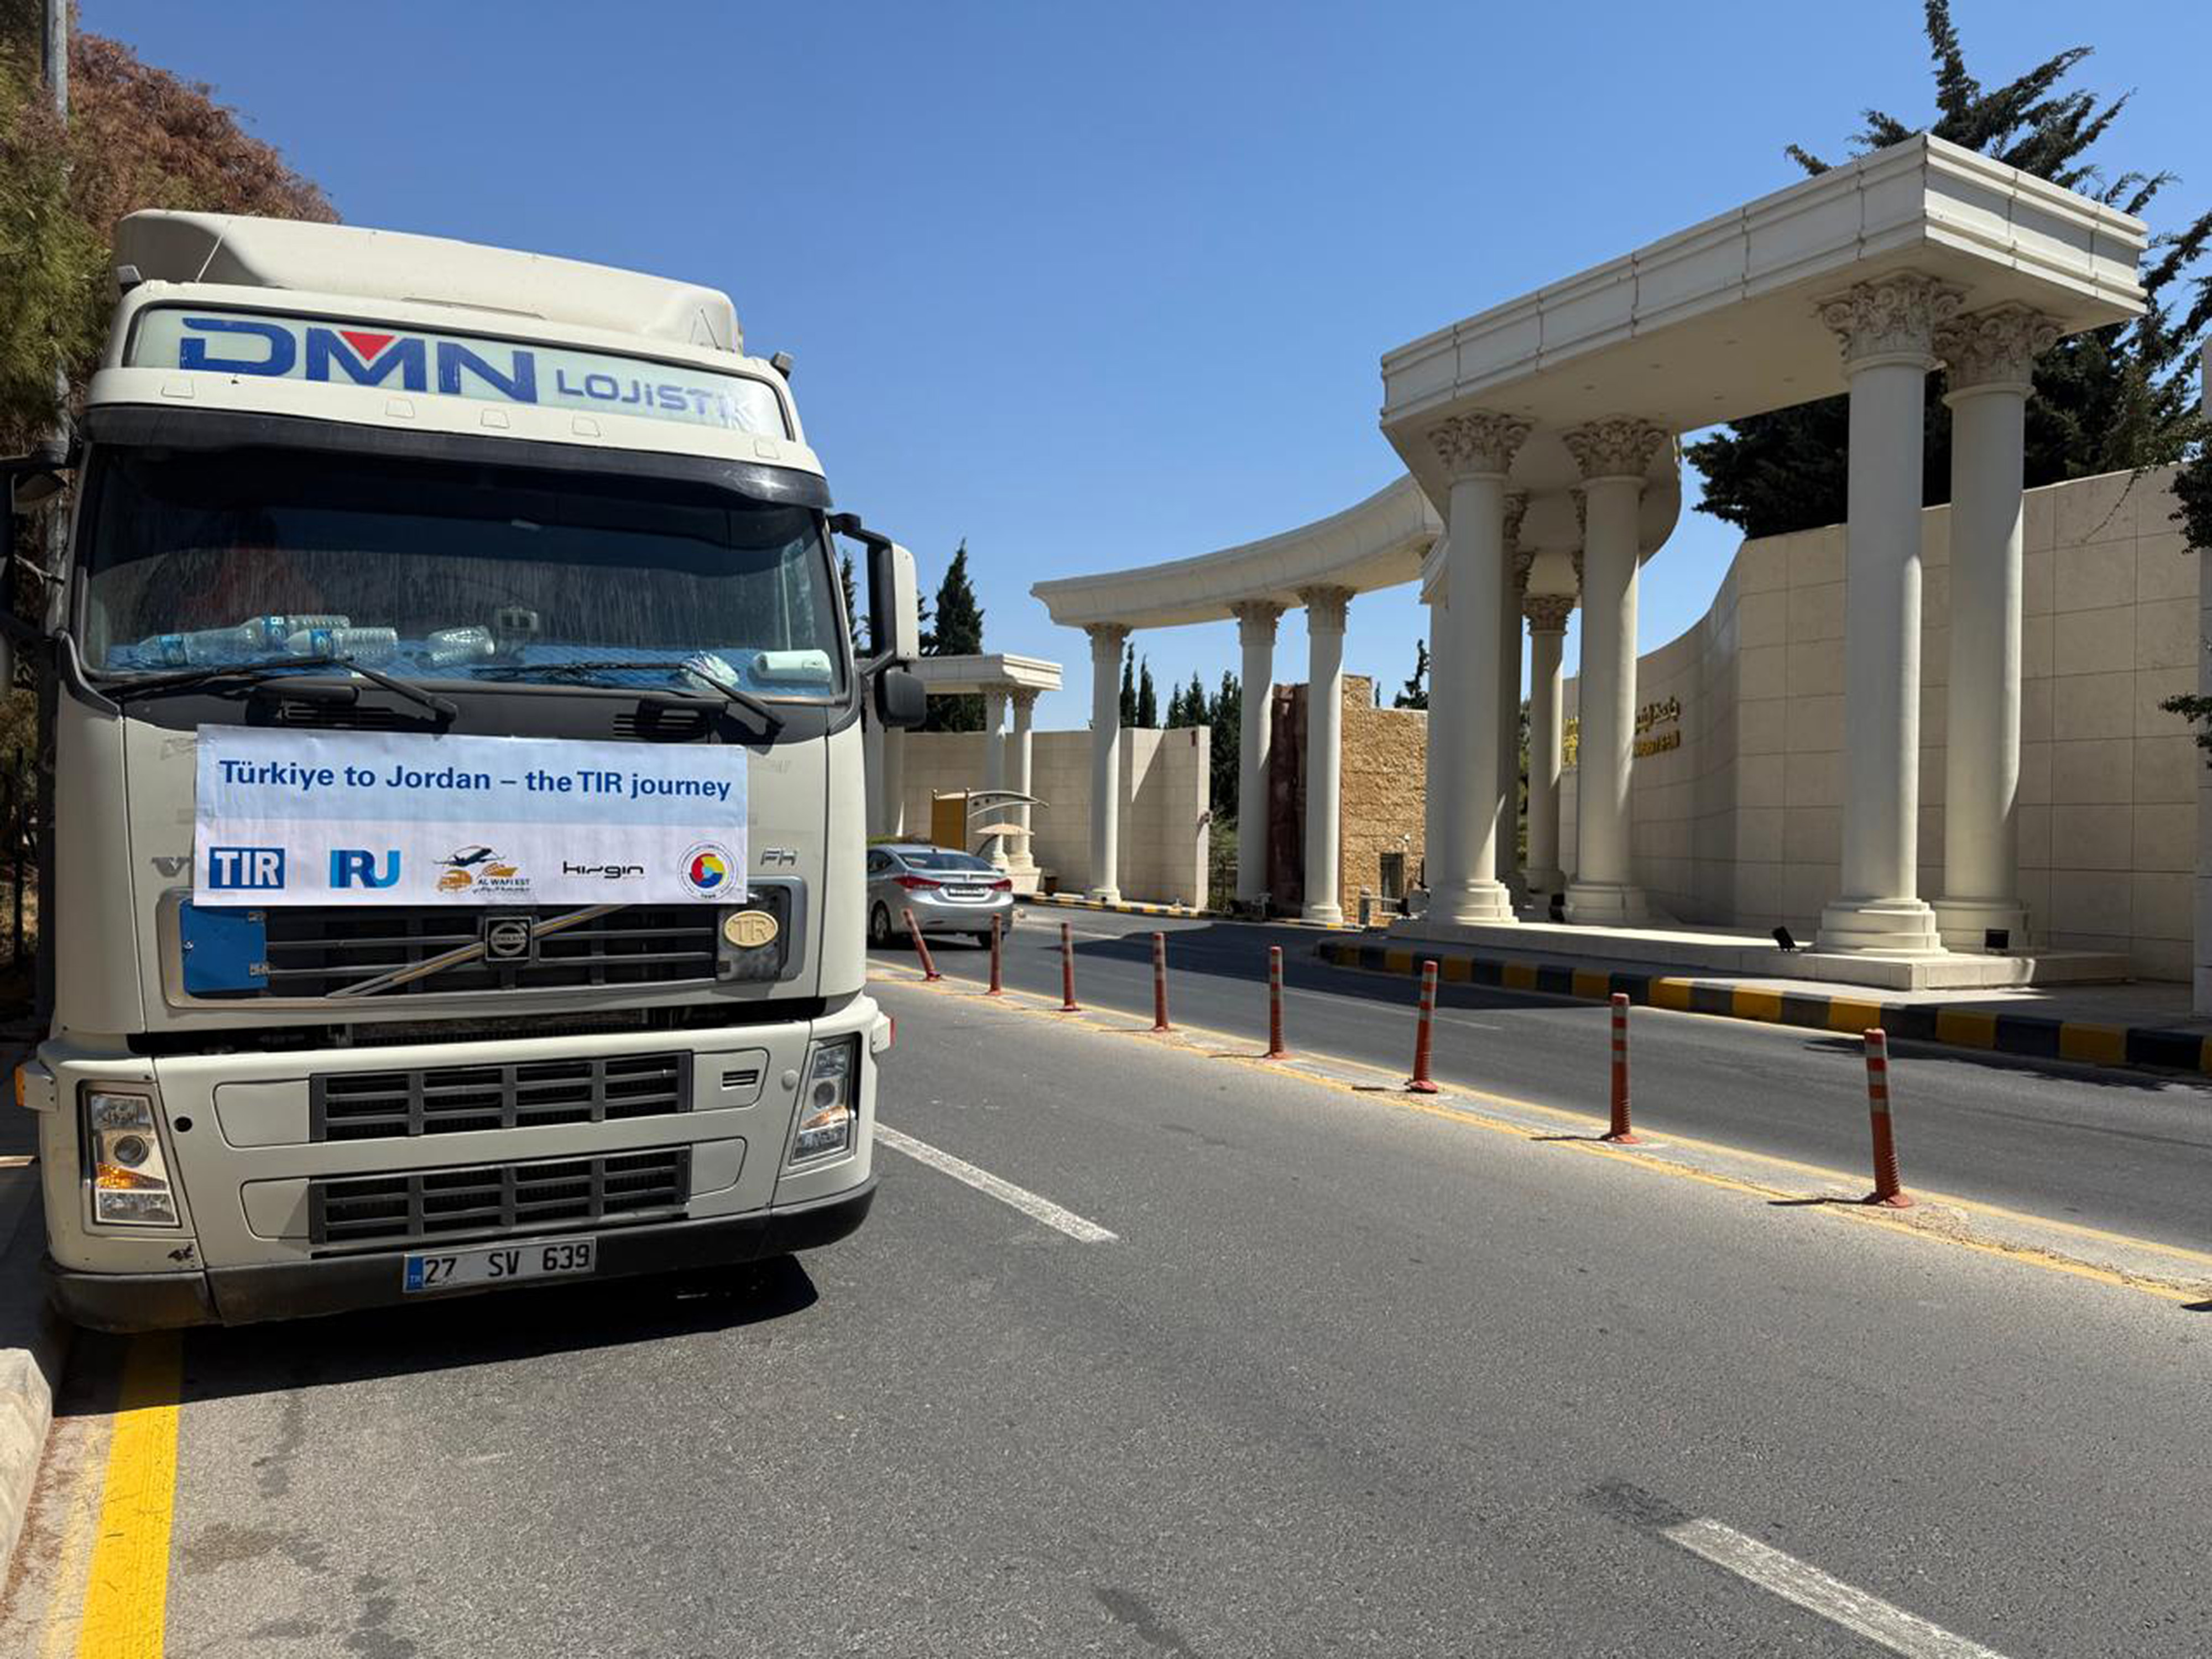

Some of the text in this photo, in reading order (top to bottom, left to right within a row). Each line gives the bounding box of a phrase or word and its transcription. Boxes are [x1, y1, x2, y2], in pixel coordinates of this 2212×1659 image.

[180, 317, 538, 404] DMN
[220, 760, 334, 790] Türkiye
[344, 766, 376, 787] to
[386, 765, 491, 790] Jordan
[525, 770, 573, 792] the
[577, 771, 623, 794] TIR
[630, 773, 732, 802] journey
[215, 851, 279, 886] TIR
[330, 850, 401, 889] IRU
[425, 1244, 590, 1285] 27 SV 639
